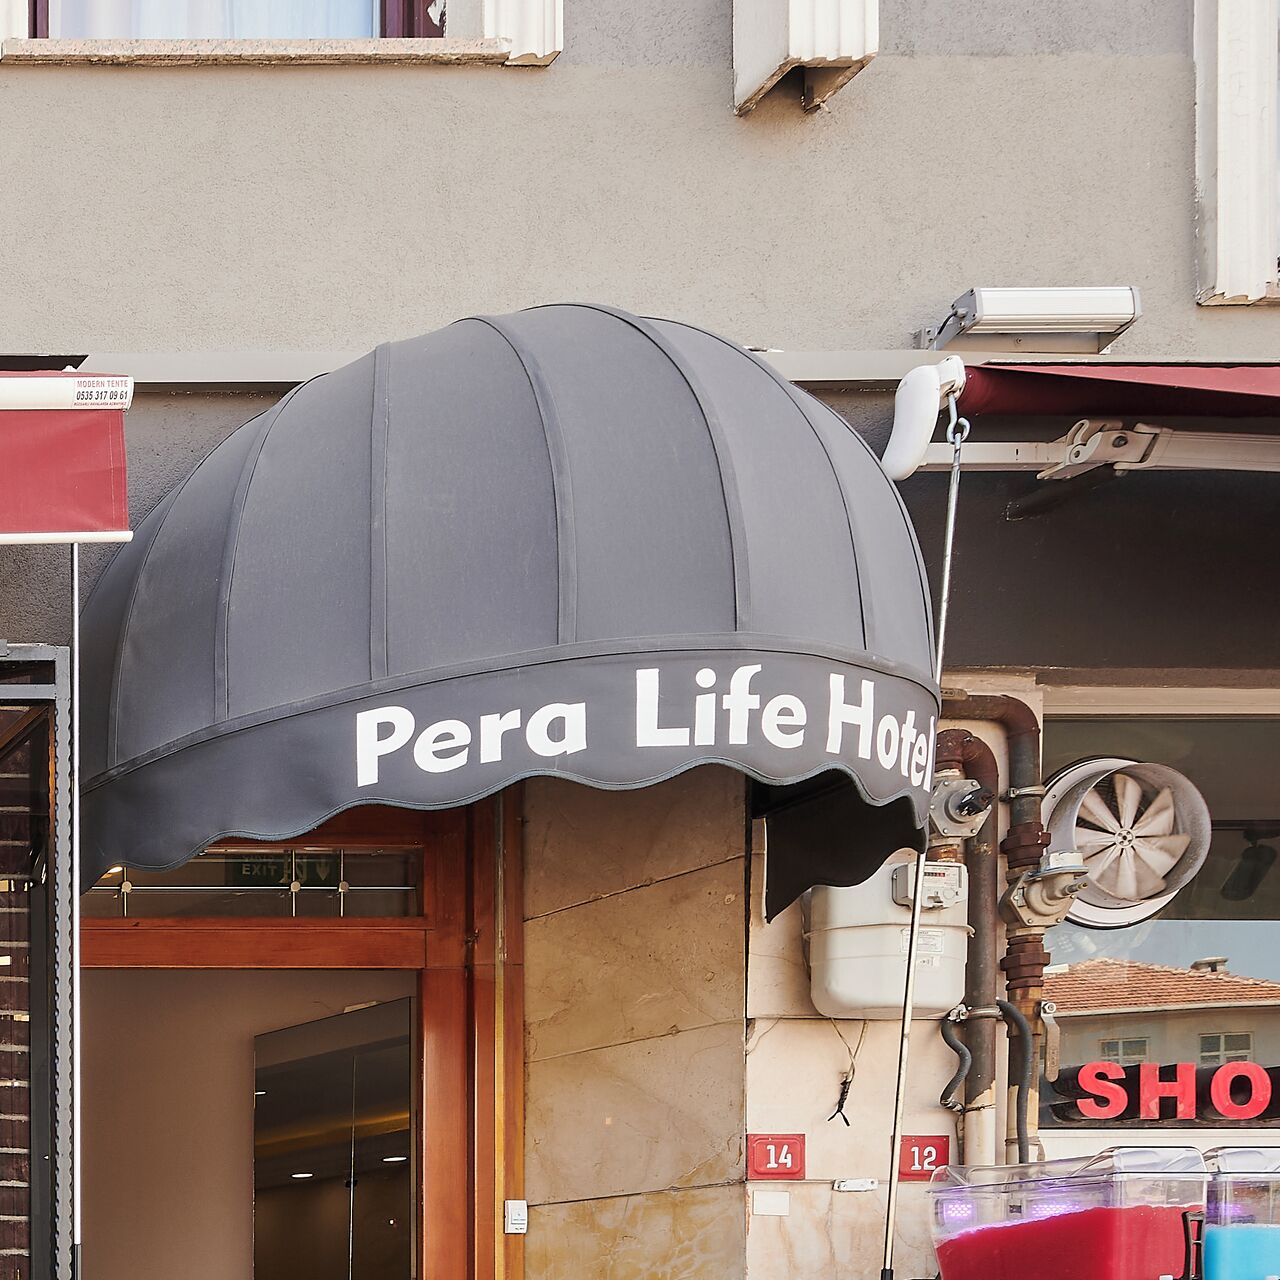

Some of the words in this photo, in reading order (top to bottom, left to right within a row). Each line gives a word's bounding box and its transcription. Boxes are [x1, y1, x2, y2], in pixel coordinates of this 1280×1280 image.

[76, 391, 93, 400] 0535
[95, 391, 108, 400] 317
[109, 391, 118, 400] 09
[120, 391, 128, 400] 61
[77, 380, 105, 388] MODERN
[107, 380, 128, 388] TENTE
[356, 702, 586, 787] Pera
[636, 664, 807, 749] Life
[826, 673, 935, 793] Hotel
[242, 863, 278, 876] EXIT
[1077, 1061, 1272, 1120] SHO
[766, 1144, 792, 1169] 14
[911, 1146, 937, 1171] 12
